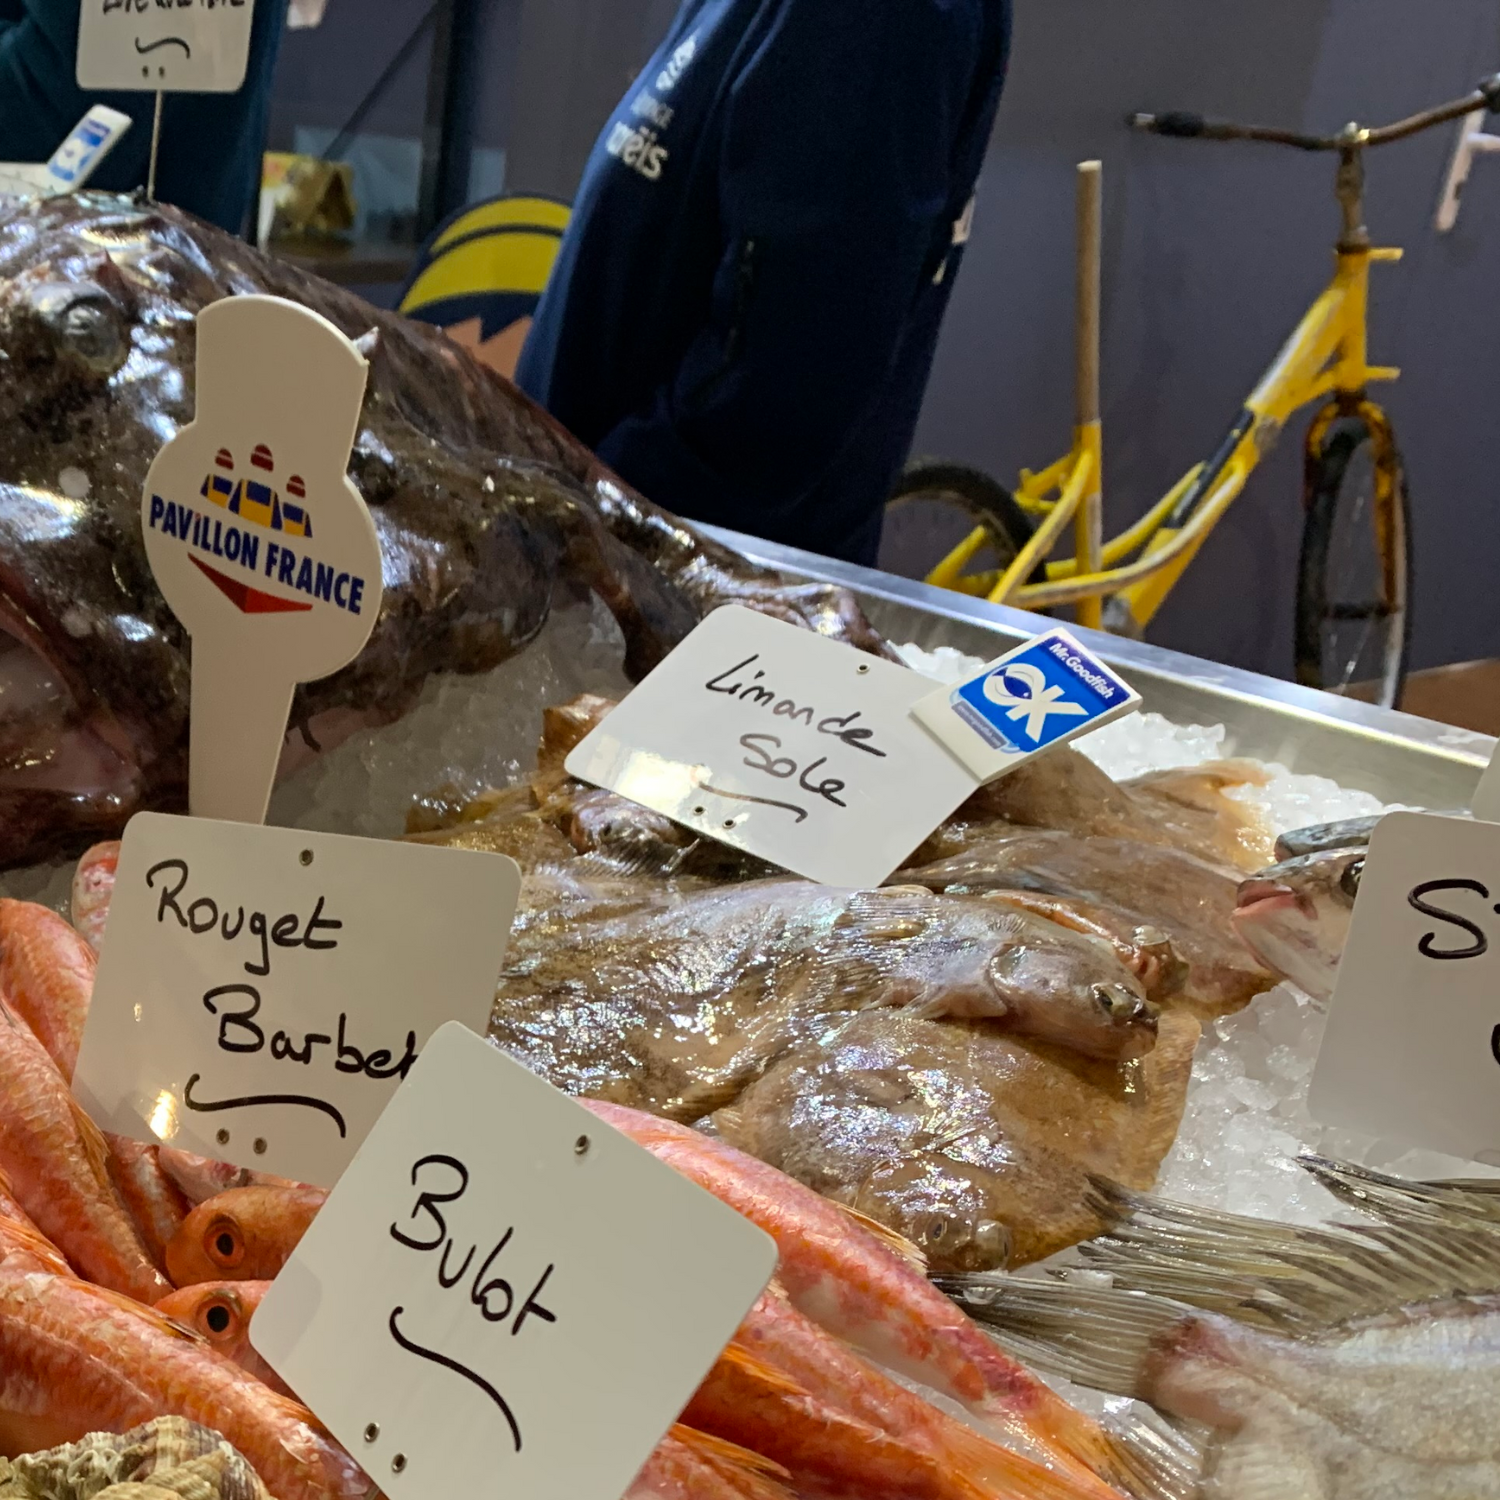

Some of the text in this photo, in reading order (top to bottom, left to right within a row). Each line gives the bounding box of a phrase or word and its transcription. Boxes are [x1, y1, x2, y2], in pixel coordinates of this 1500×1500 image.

[264, 541, 365, 615] FRANCE
[705, 654, 887, 757] Limande
[982, 662, 1089, 744] OK
[739, 733, 847, 808] Sole
[146, 858, 343, 976] Rouget
[1407, 878, 1500, 960] S
[389, 1153, 557, 1336] Bulot
